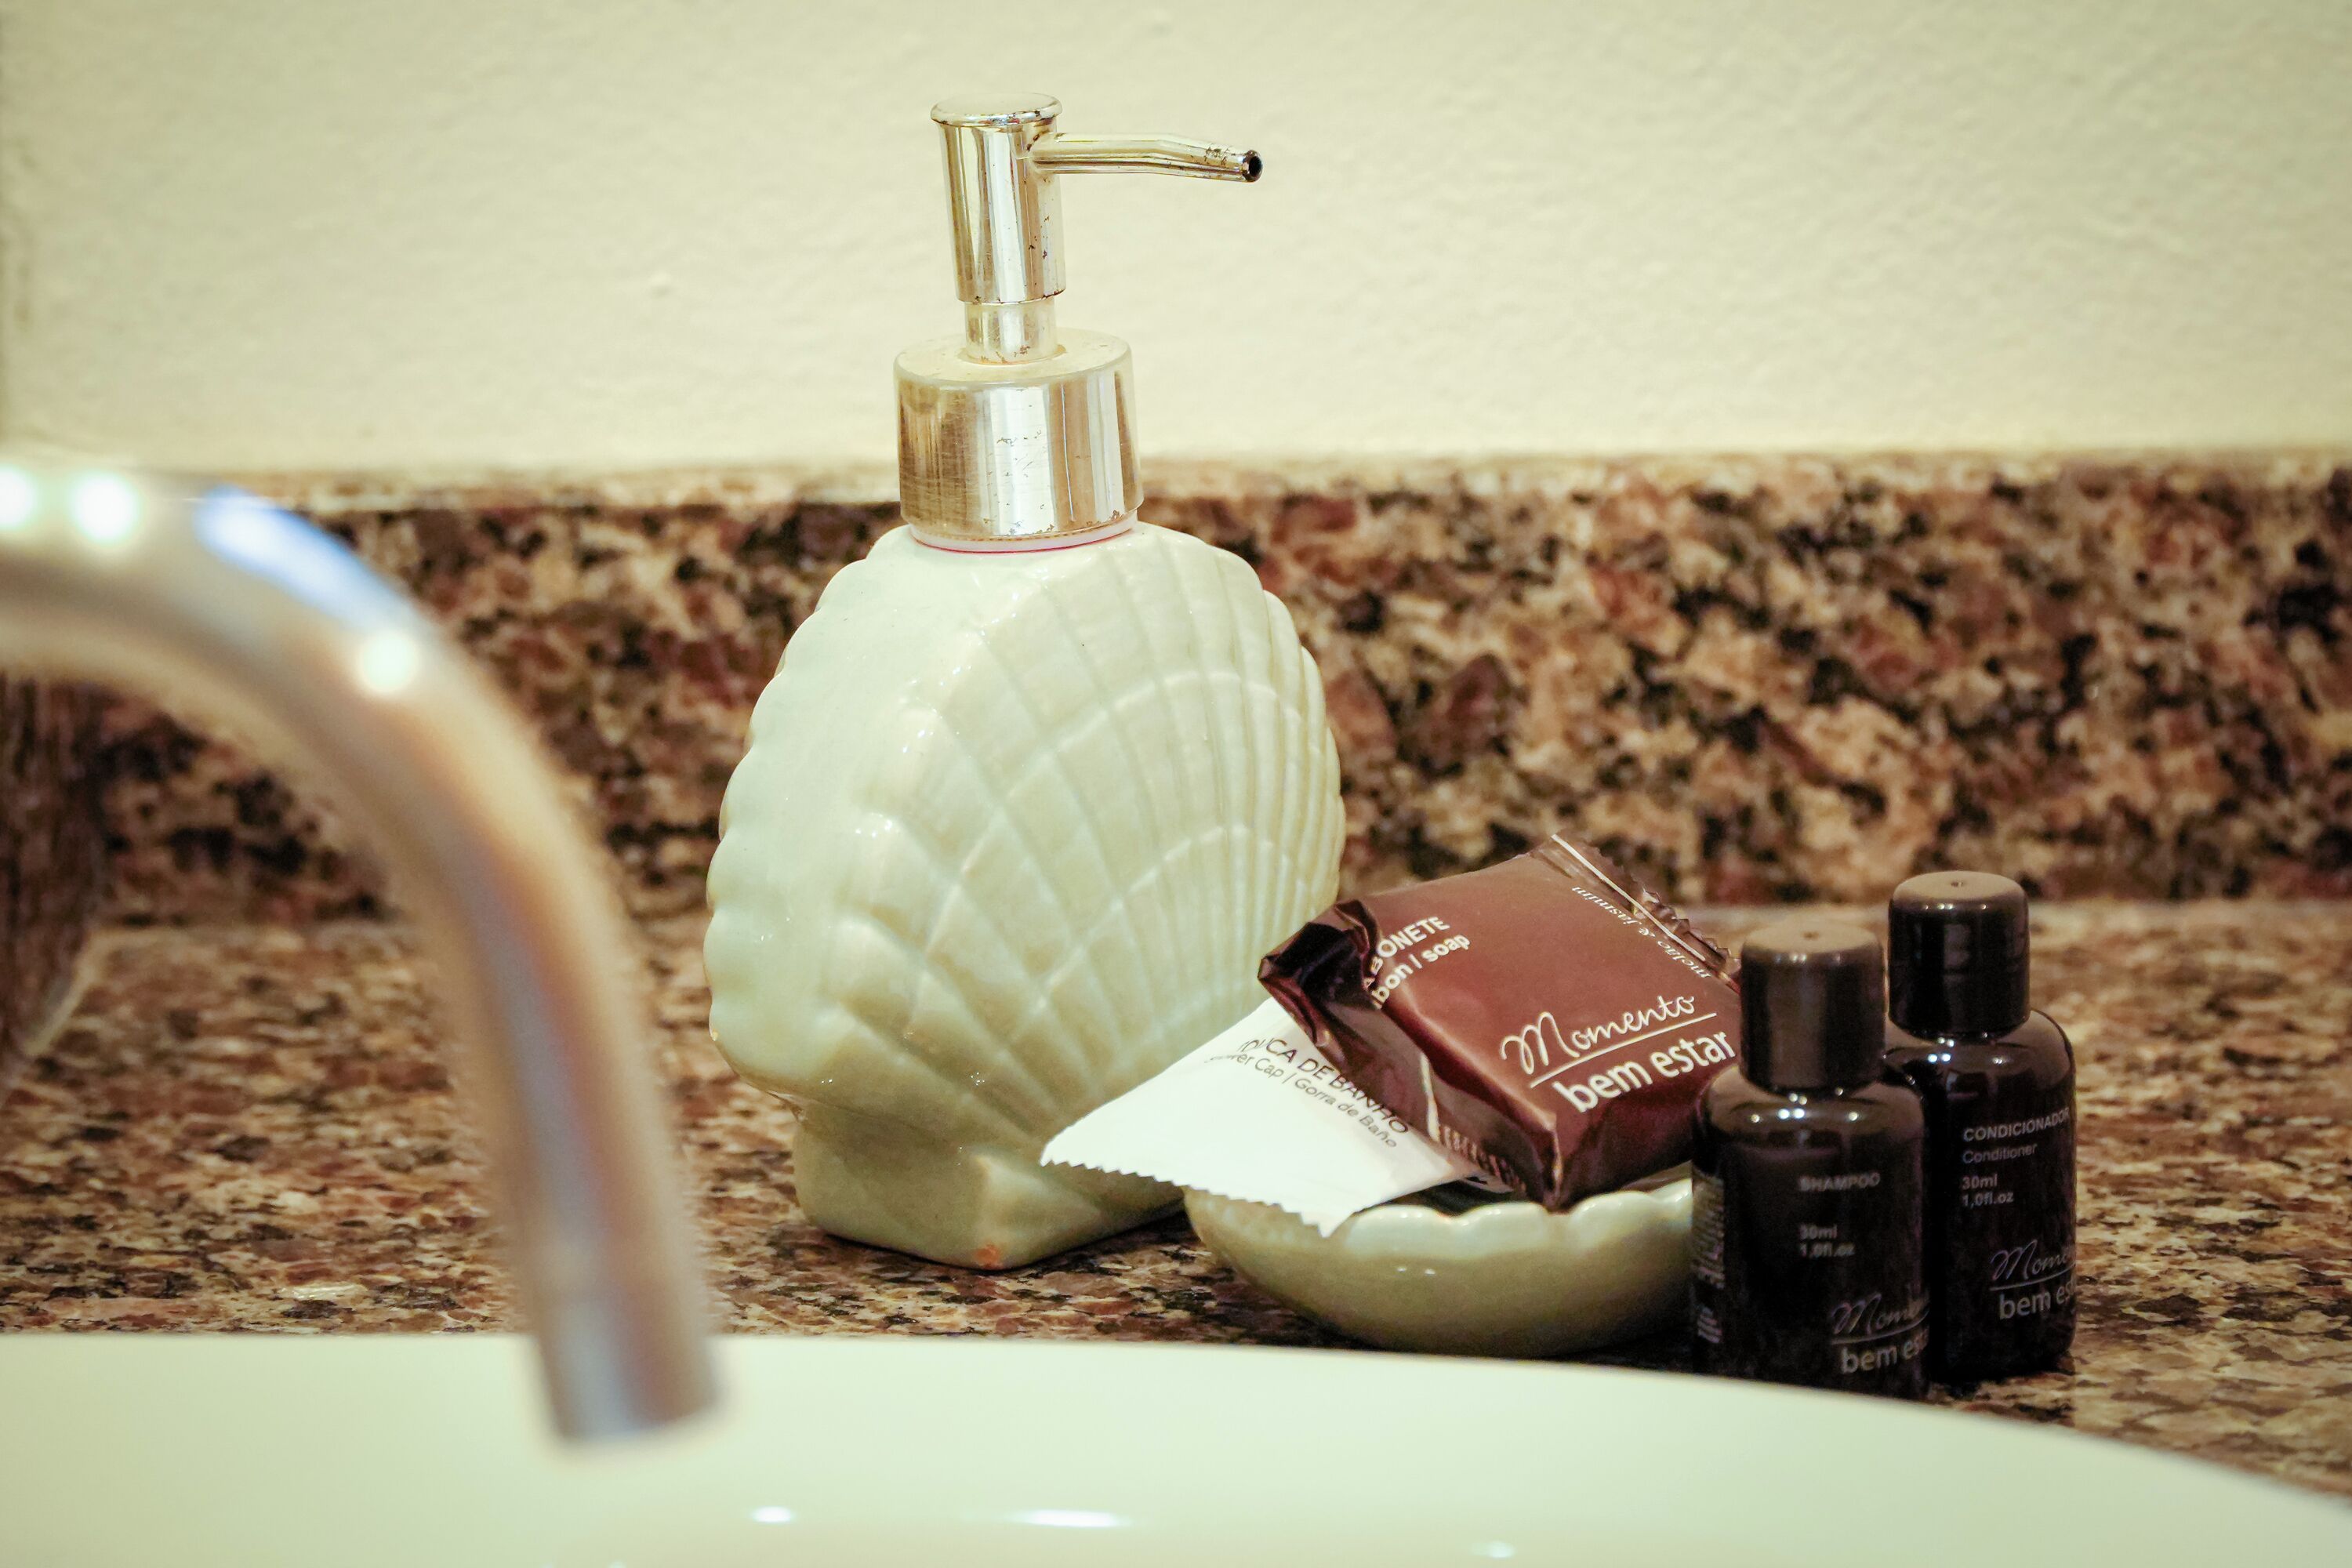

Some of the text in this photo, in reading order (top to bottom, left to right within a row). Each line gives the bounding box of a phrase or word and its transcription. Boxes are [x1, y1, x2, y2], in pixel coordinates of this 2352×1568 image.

[1362, 916, 1450, 990] ABONETE
[1421, 934, 1471, 963] soap
[1499, 995, 1695, 1075] Momento
[1297, 1058, 1334, 1080] DE
[1552, 1031, 1737, 1113] bem estar
[1254, 1058, 1285, 1079] Cap
[1294, 1076, 1338, 1105] Gorra
[1337, 1102, 1360, 1117] de
[1962, 1143, 2038, 1164] Conditioner
[1799, 1171, 1881, 1192] SHAMPOO
[1962, 1174, 1998, 1190] 30ml
[1999, 1290, 2052, 1320] bem
[1842, 1345, 1897, 1374] bem
